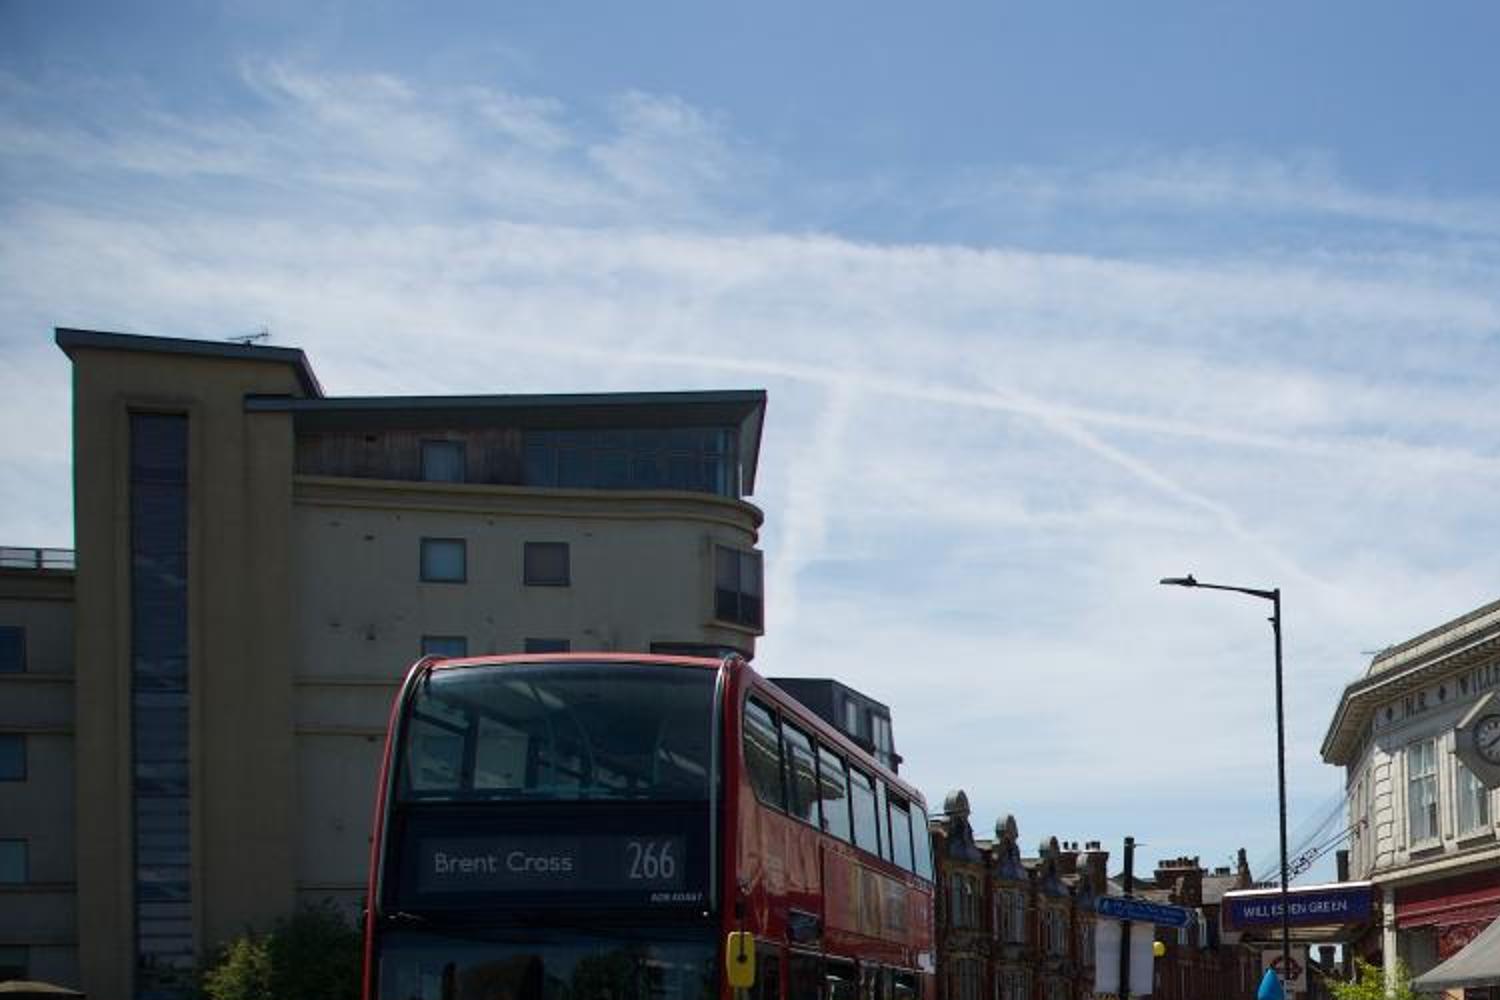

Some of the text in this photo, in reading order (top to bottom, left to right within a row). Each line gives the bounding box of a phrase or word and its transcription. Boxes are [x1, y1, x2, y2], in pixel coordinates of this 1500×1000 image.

[434, 851, 573, 873] Brent Cross
[628, 841, 675, 880] 266
[1243, 899, 1348, 918] WILLESEN GREEN
